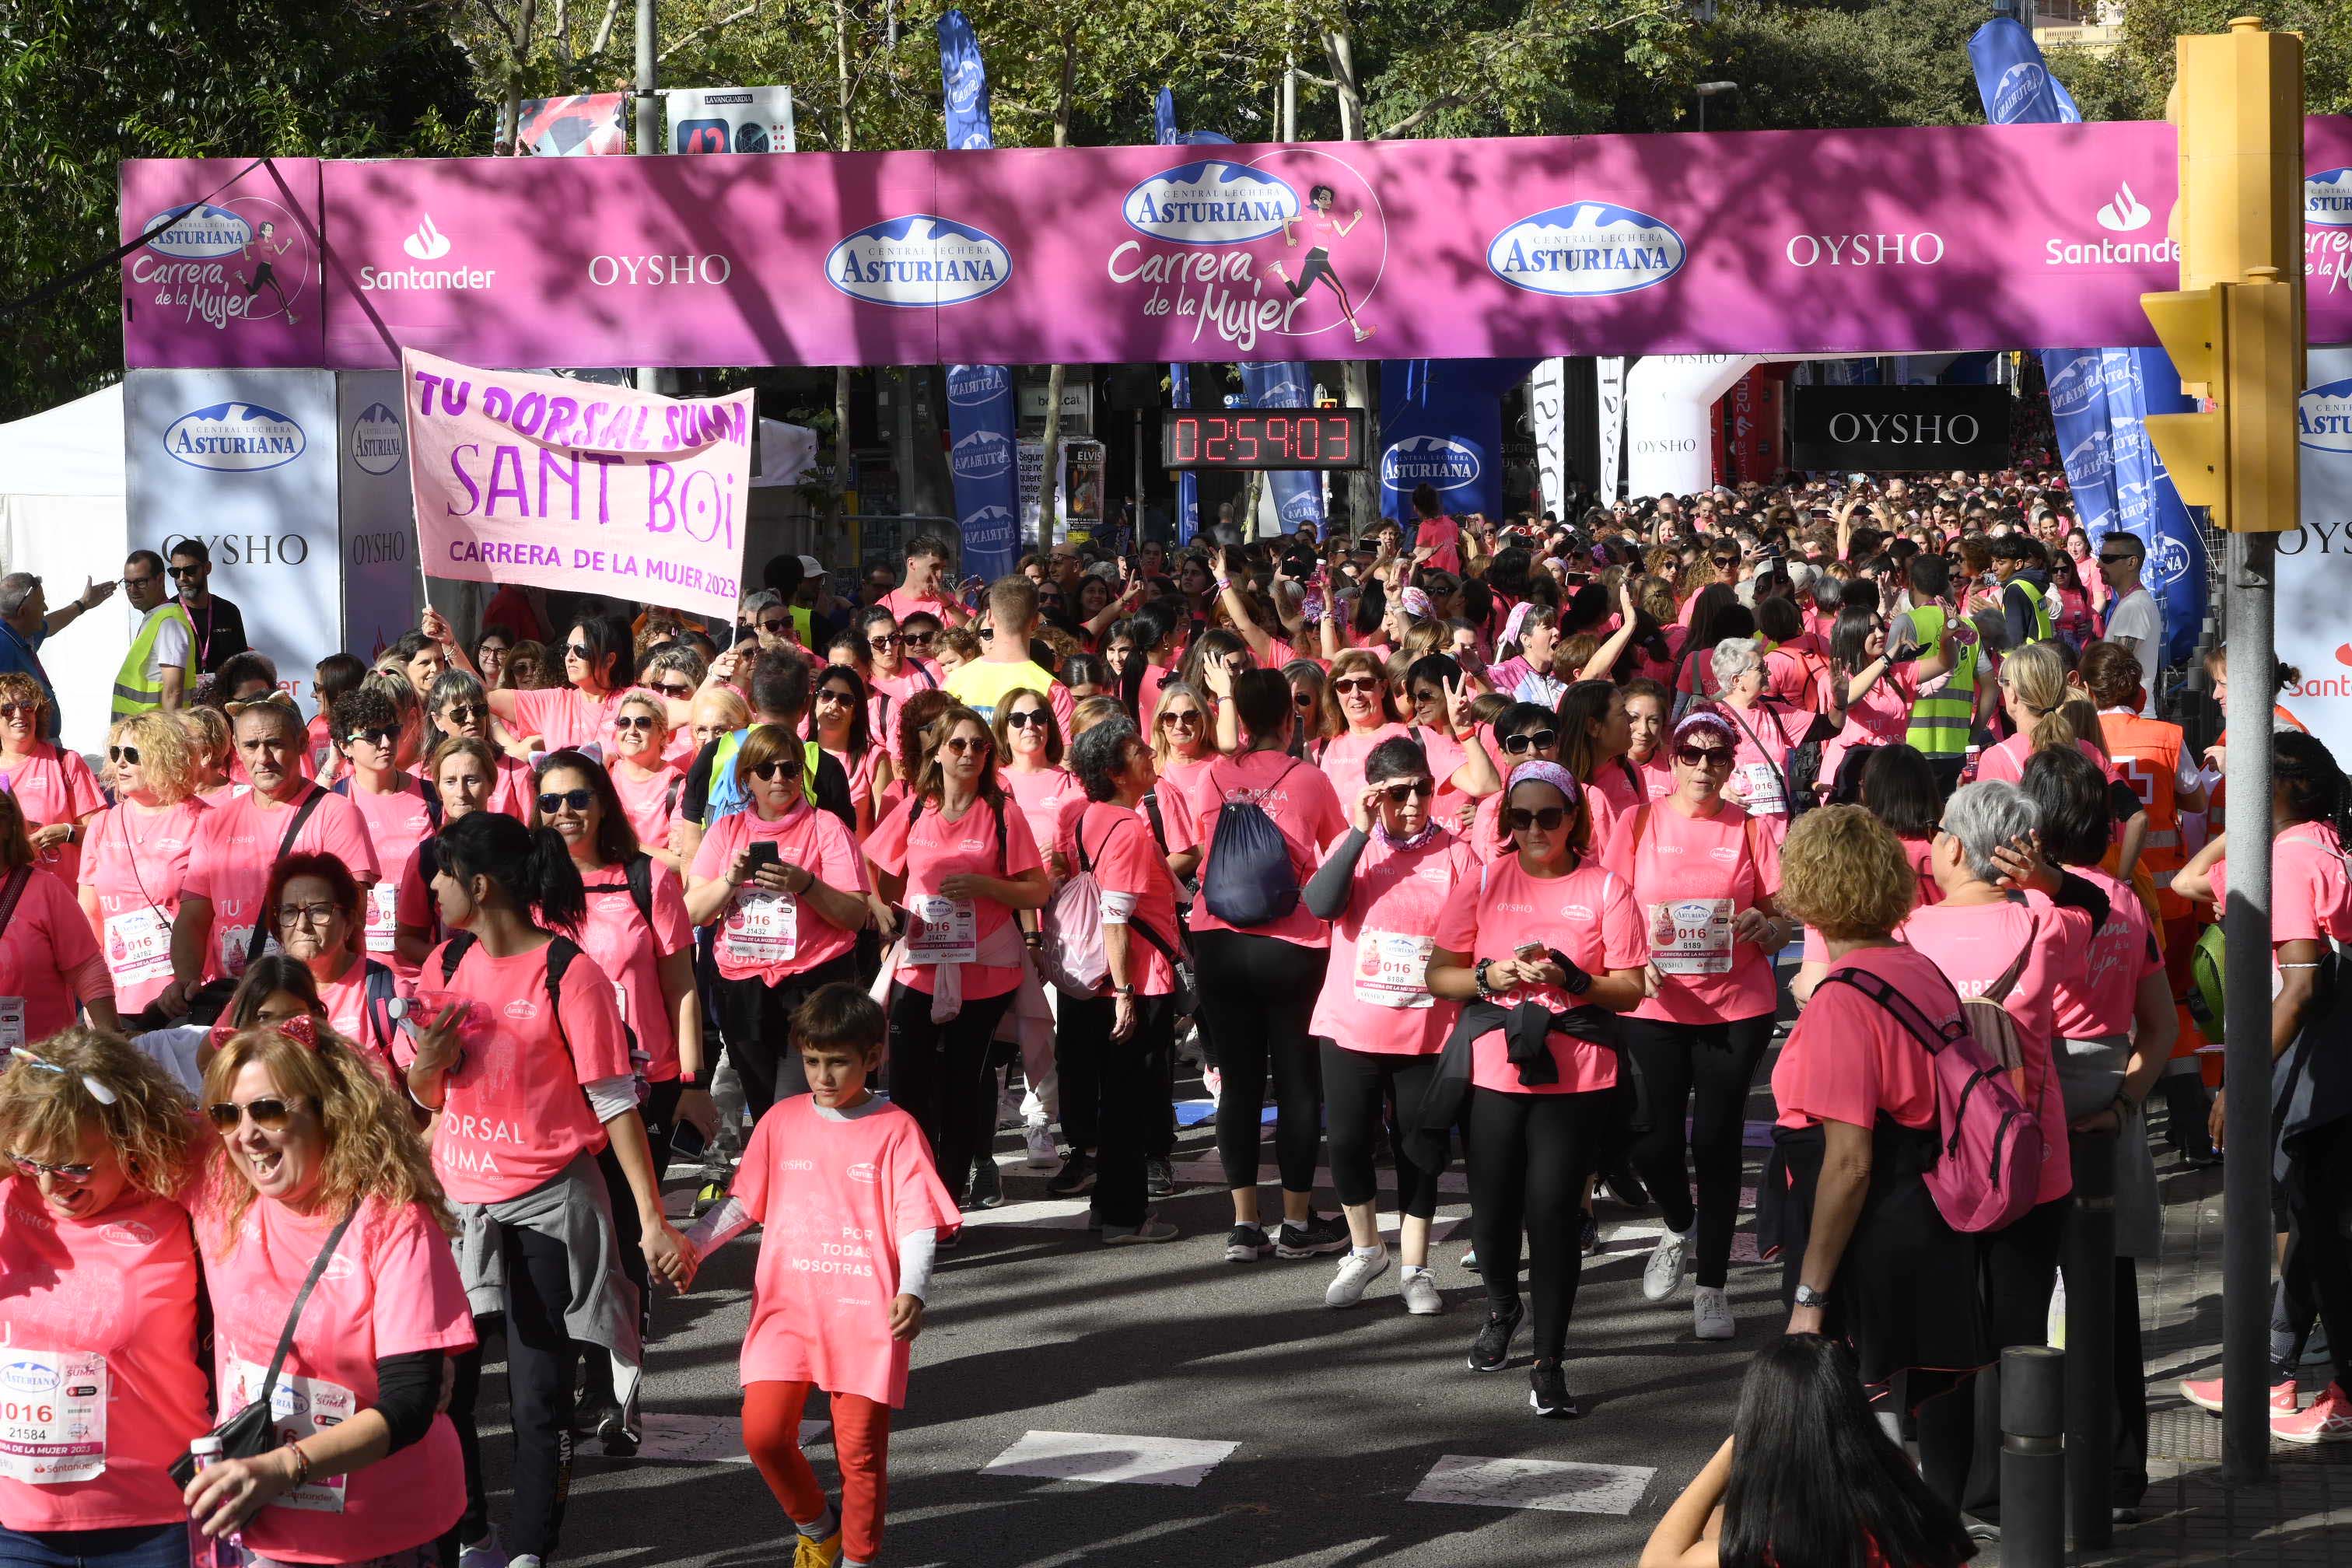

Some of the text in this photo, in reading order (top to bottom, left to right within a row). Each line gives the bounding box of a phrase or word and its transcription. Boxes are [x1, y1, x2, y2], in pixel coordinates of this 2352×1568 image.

[714, 94, 752, 104] VANGUARDIA
[1164, 187, 1281, 198] CENTRAL LECHERA
[1138, 192, 1286, 224] ASTURIANA
[152, 223, 243, 244] ASTURIANA
[1532, 233, 1664, 245] CENTRAL LECHERA
[868, 246, 928, 255] CENTRAL
[1502, 237, 1671, 274] ASTURIANA
[1786, 231, 1944, 268] OYSHO
[2045, 236, 2182, 265] Santande
[132, 254, 224, 284] Carrera
[589, 254, 731, 286] OYSHO
[841, 250, 997, 284] ASTURIANA
[1108, 240, 1251, 284] Carrera
[360, 266, 496, 291] Santander
[156, 285, 187, 306] de la
[185, 281, 258, 330] Mujer
[1143, 285, 1195, 317] de la
[1191, 280, 1308, 352] Mujer
[415, 370, 746, 451] TU DORSAL SUMA
[1829, 411, 1979, 445] OYSHO
[175, 428, 296, 454] ASTURIANA
[355, 430, 401, 457] ASTURIANA
[1176, 418, 1349, 460] 02:59:03
[1637, 438, 1696, 454] OYSHO
[1077, 451, 1102, 461] ELVIS
[1020, 474, 1045, 483] quiere
[1384, 458, 1472, 480] ASTURIANA
[446, 443, 625, 525] SANT
[161, 534, 309, 566] OSHO
[353, 530, 405, 565] OYSHO
[450, 541, 737, 599] CARRERA DE LA MUJER 2023
[1866, 719, 1881, 731] TU
[1755, 782, 1773, 791] 016
[221, 899, 240, 917] TU
[1677, 910, 1709, 919] ASTURIANA
[746, 915, 771, 926] 016
[926, 921, 950, 932] 016
[128, 936, 152, 951] 016
[1678, 928, 1707, 939] 016
[1383, 961, 1411, 974] 016
[103, 1228, 152, 1244] ASTURIANA
[842, 1226, 873, 1242] POR
[821, 1242, 873, 1258] TODAS
[792, 1256, 873, 1277] NOSOTRAS
[4, 1370, 58, 1387] ASTURIANA
[66, 1369, 96, 1377] SUMA
[5, 1402, 53, 1423] 016
[315, 1398, 345, 1409] SUMA
[9, 1426, 47, 1440] 21584
[12, 1444, 23, 1453] DE
[23, 1445, 36, 1454] LA
[37, 1445, 68, 1455] MUJER
[70, 1444, 92, 1454] 2023
[46, 1461, 94, 1474] Santander
